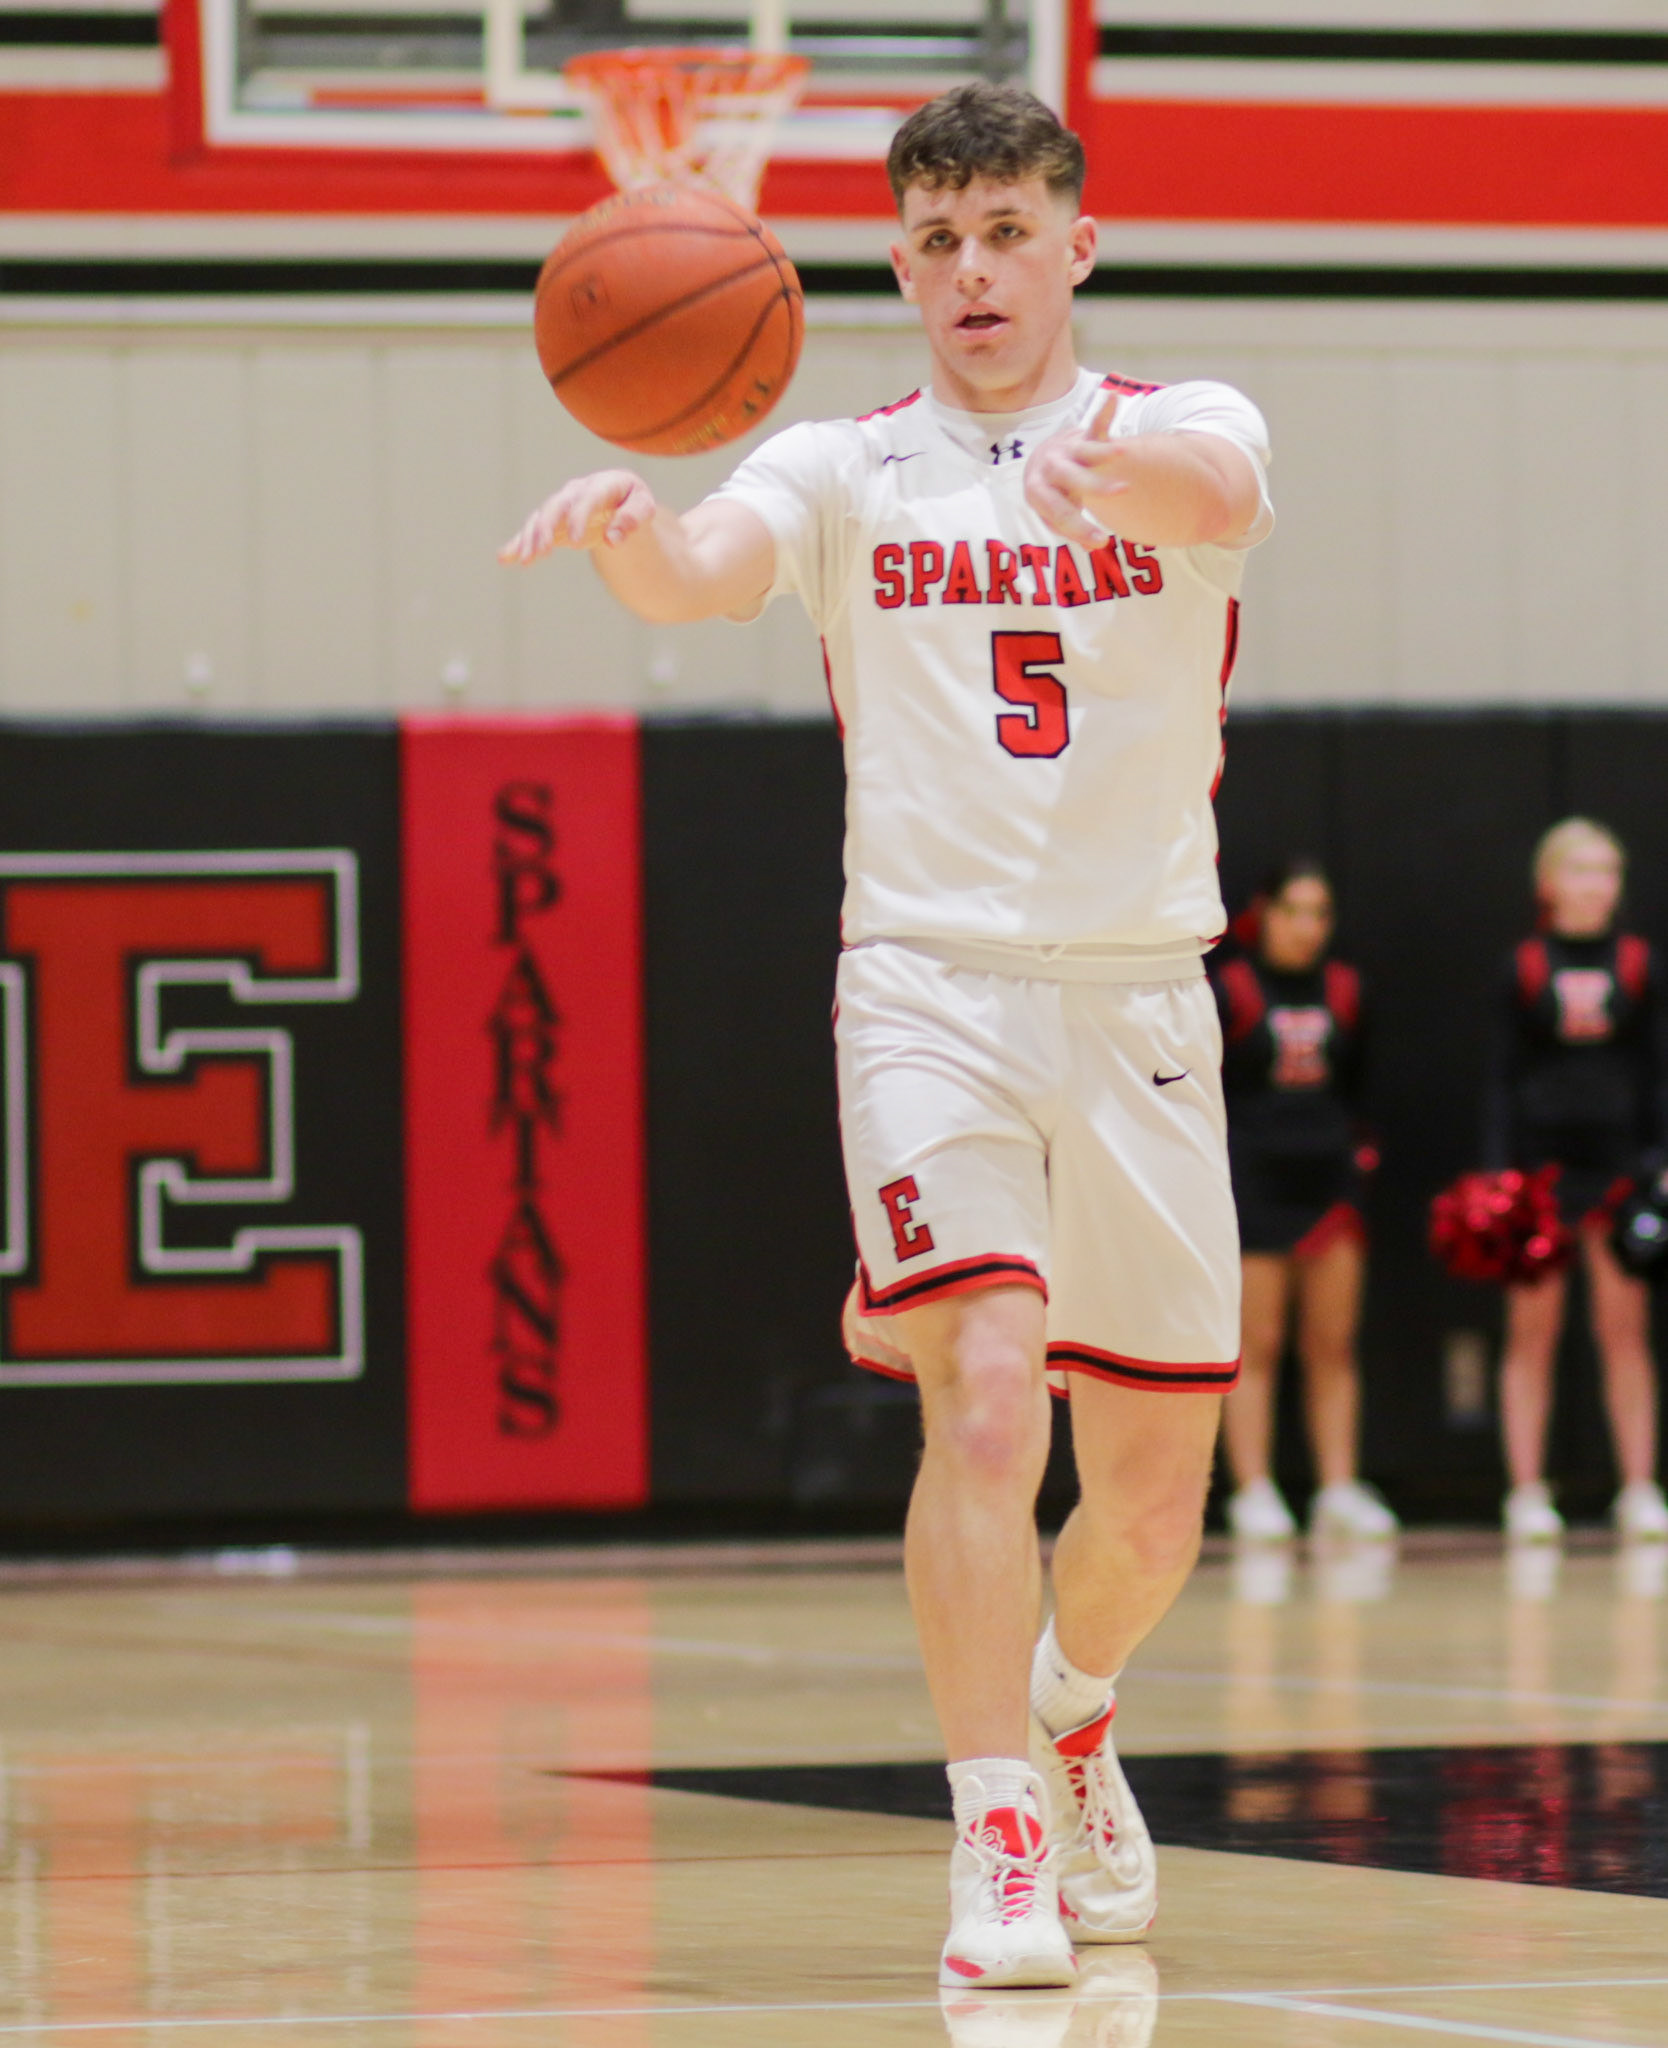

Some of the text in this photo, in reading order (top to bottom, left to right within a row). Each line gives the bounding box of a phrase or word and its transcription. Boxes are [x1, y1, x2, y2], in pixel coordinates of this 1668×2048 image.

[873, 535, 1163, 609] SPARTANS
[991, 631, 1070, 758] 5
[0, 848, 363, 1388] E
[491, 782, 566, 1440] SPARTANS
[878, 1174, 936, 1263] E
